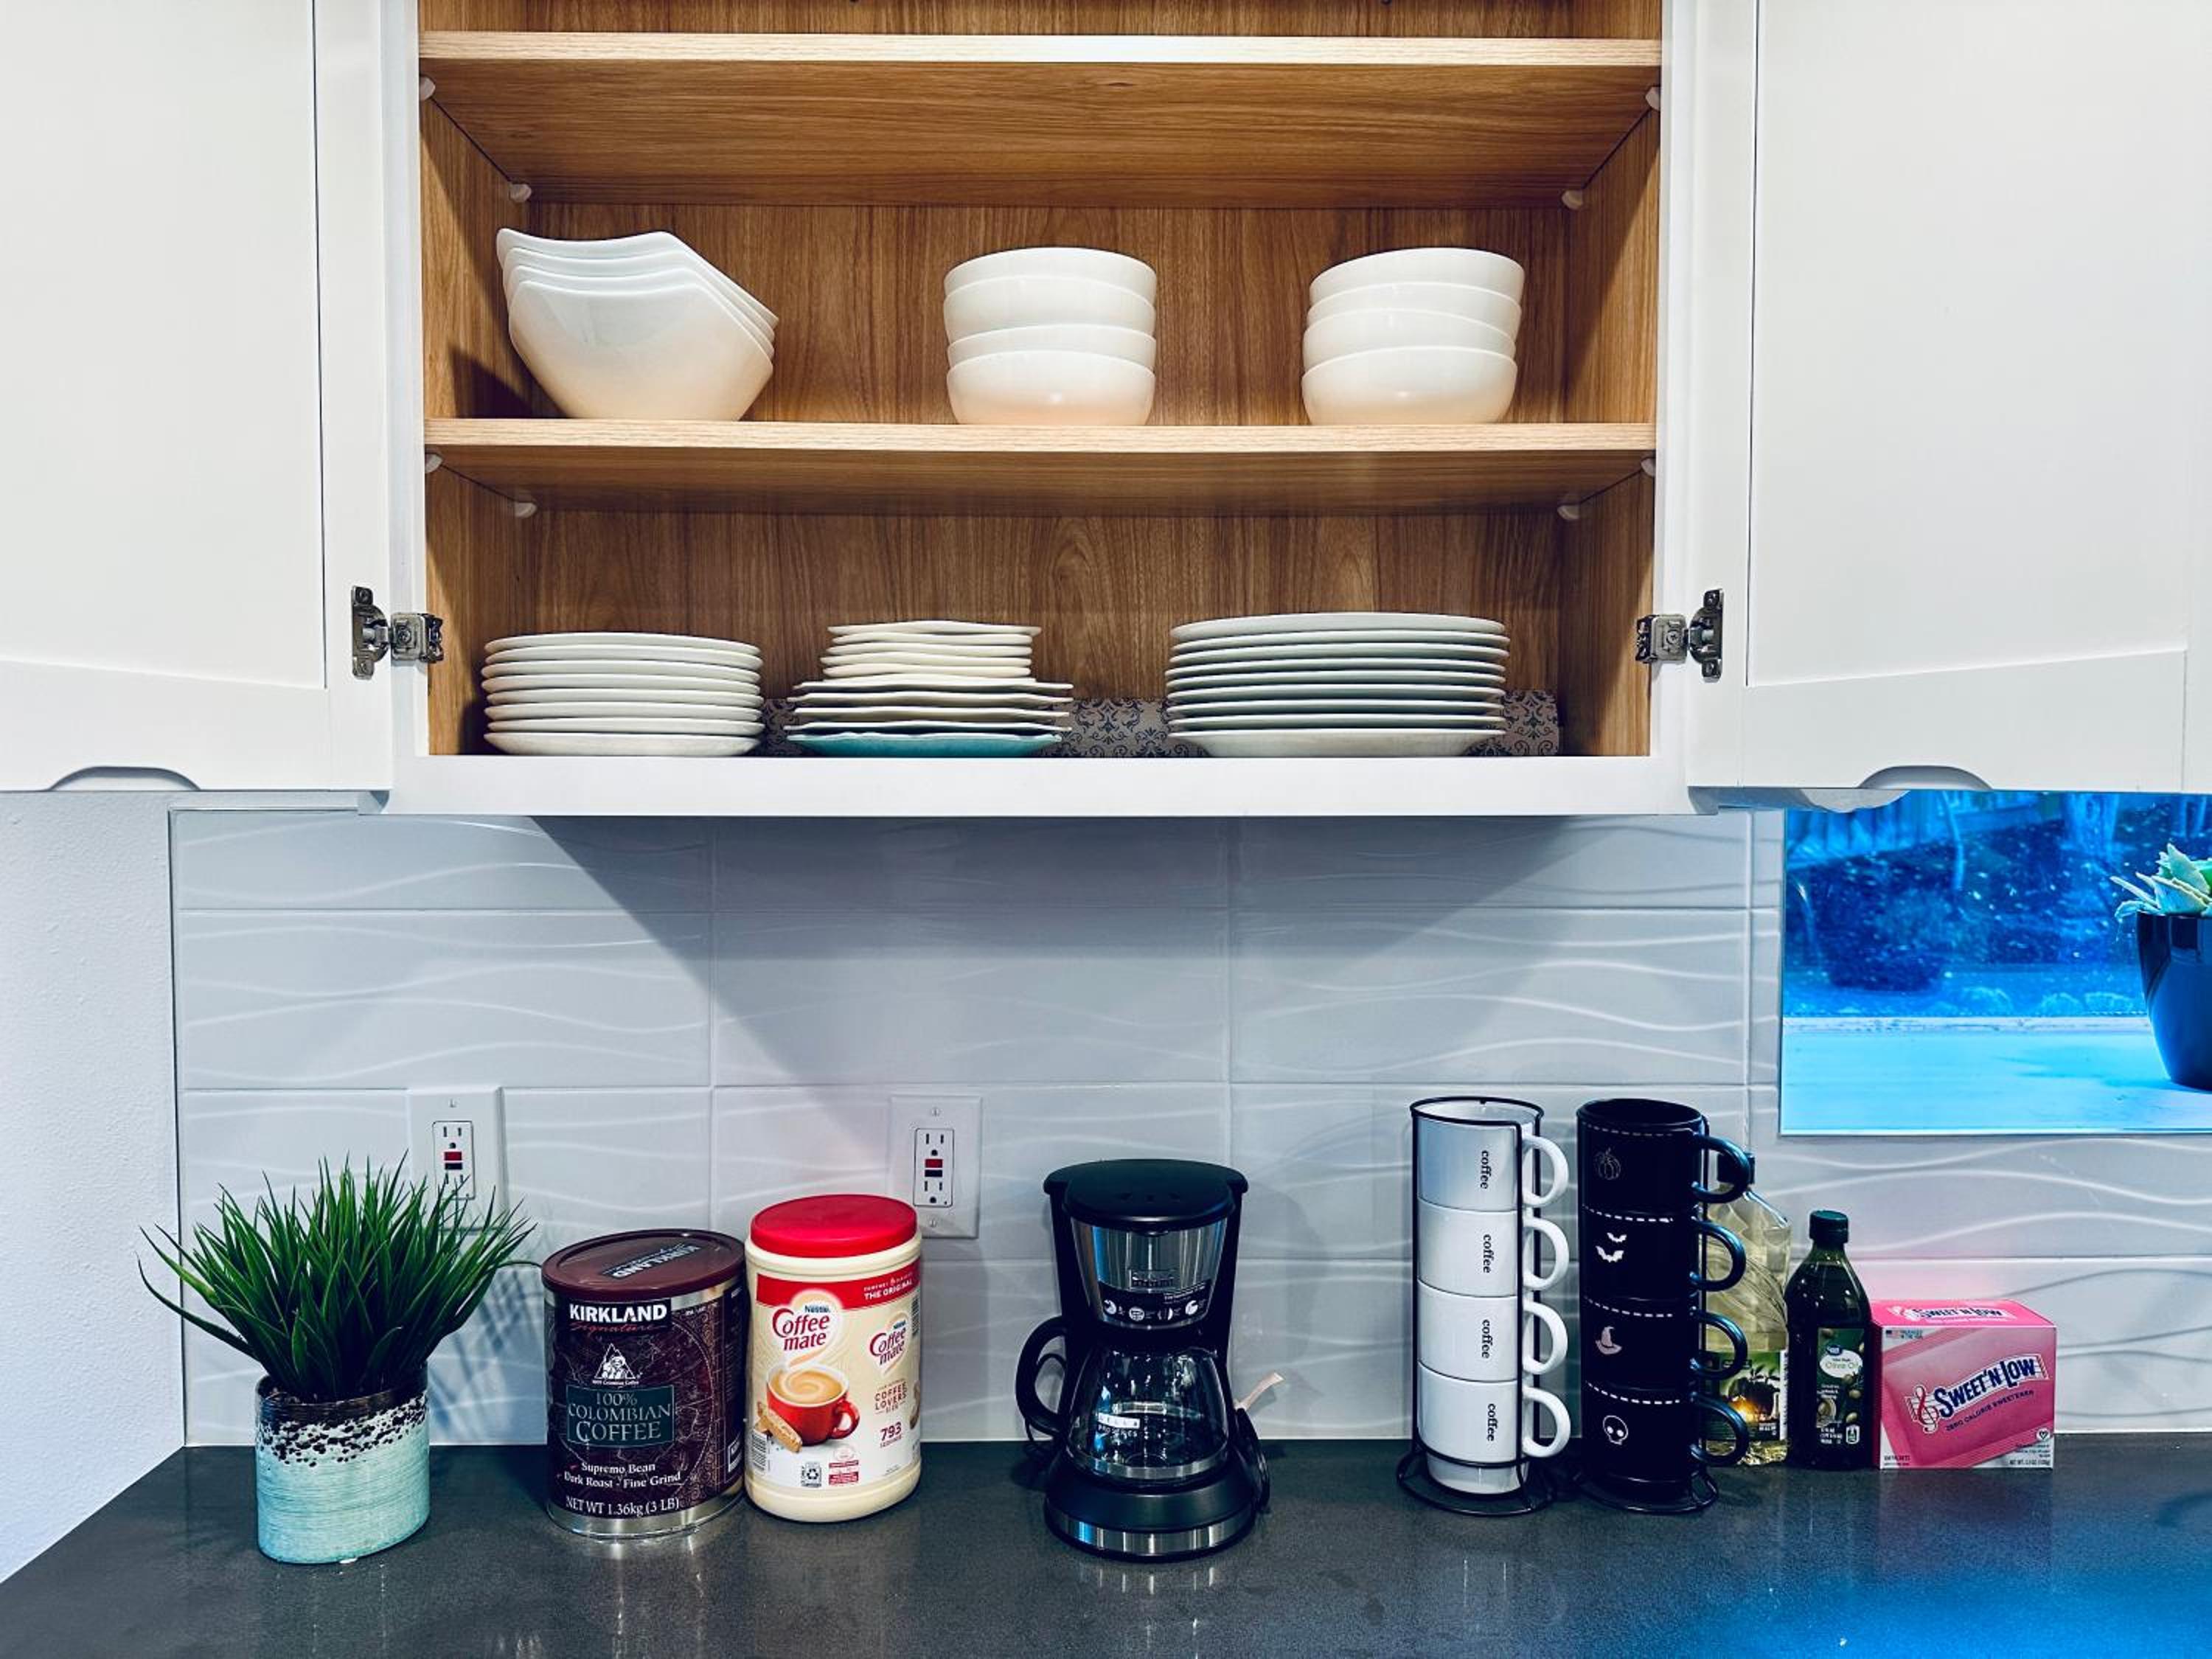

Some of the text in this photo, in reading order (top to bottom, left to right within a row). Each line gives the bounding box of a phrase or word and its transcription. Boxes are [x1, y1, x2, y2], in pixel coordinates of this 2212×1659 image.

[1480, 1150, 1492, 1189] coffee
[1483, 1234, 1495, 1273] coffee
[863, 1290, 881, 1301] THE
[569, 1304, 667, 1323] KIRKLAND
[772, 1308, 830, 1338] Coffee
[784, 1332, 827, 1351] mate
[869, 1327, 907, 1357] Coffee
[1481, 1319, 1493, 1359] coffee
[879, 1340, 905, 1365] mate
[1999, 1357, 2037, 1388] LOW
[597, 1392, 637, 1406] 100%
[874, 1381, 907, 1402] COFFEE
[875, 1391, 907, 1411] LOVERS
[568, 1403, 672, 1422] COLOMBIAN
[1946, 1389, 2034, 1432] ZERO CALORIE SWEETENER
[576, 1421, 661, 1442] COFFEE
[880, 1421, 902, 1442] 793
[1486, 1403, 1498, 1441] coffee
[581, 1462, 656, 1475] Supremo Bean
[564, 1471, 584, 1485] Dark
[585, 1477, 613, 1488] Roast
[623, 1478, 647, 1489] Fine
[650, 1471, 681, 1486] Grind
[566, 1495, 680, 1517] NET WT 1.36kg (3 LB)
